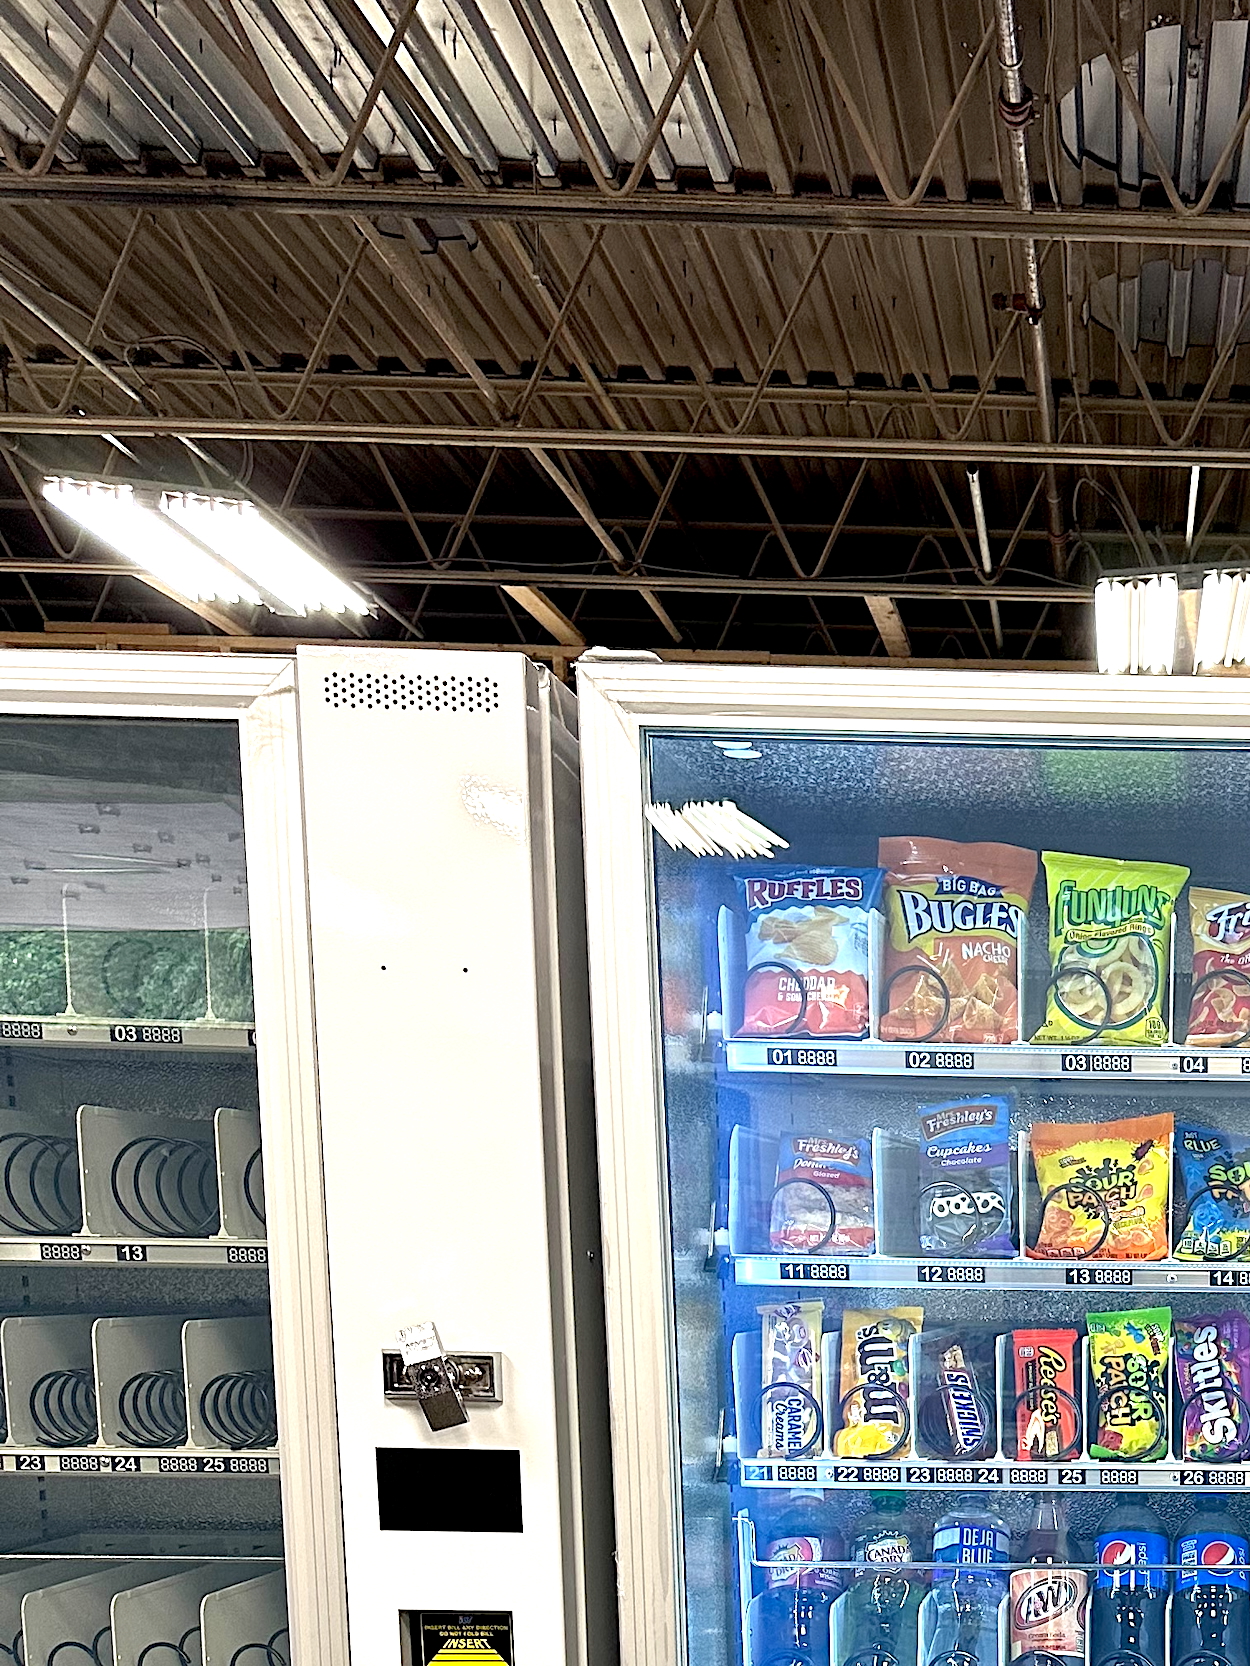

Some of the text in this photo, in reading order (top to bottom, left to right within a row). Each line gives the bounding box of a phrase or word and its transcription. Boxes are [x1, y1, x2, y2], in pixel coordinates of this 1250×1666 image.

[746, 877, 862, 908] RUFFLES
[941, 878, 996, 896] BIG BAG
[1055, 880, 1171, 936] FUNYUNS
[899, 891, 1018, 943] BUGLES
[961, 942, 1010, 958] NACHO
[114, 1026, 181, 1042] 03 8888
[772, 1050, 836, 1066] 01 8888
[909, 1052, 973, 1068] 02 8888
[1065, 1055, 1130, 1071] 03 8888
[1182, 1058, 1204, 1074] 04
[926, 1109, 993, 1133] Freshley's
[927, 1141, 992, 1159] Cupcakes
[1184, 1139, 1220, 1152] BLUE
[940, 1155, 982, 1167] Chocolate
[812, 1170, 840, 1179] Glazed
[1069, 1169, 1136, 1193] SOUR
[785, 1264, 848, 1279] 11 8888
[921, 1267, 984, 1282] 12 8888
[1069, 1269, 1131, 1284] 13 8888
[1214, 1271, 1234, 1285] 14
[1038, 1346, 1067, 1425] Reese's
[1126, 1353, 1154, 1421] SOUR
[1190, 1323, 1237, 1446] Skittles
[945, 1372, 983, 1452] SNICKERS
[774, 1402, 789, 1449] Creams
[203, 1458, 267, 1472] 25 8888
[838, 1467, 899, 1482] 22 8888
[1062, 1469, 1137, 1484] 25 8888
[1184, 1471, 1244, 1485] 26 8888
[963, 1528, 994, 1546] DEJA
[1025, 1581, 1070, 1623] A&W
[442, 1638, 492, 1649] INSERT
